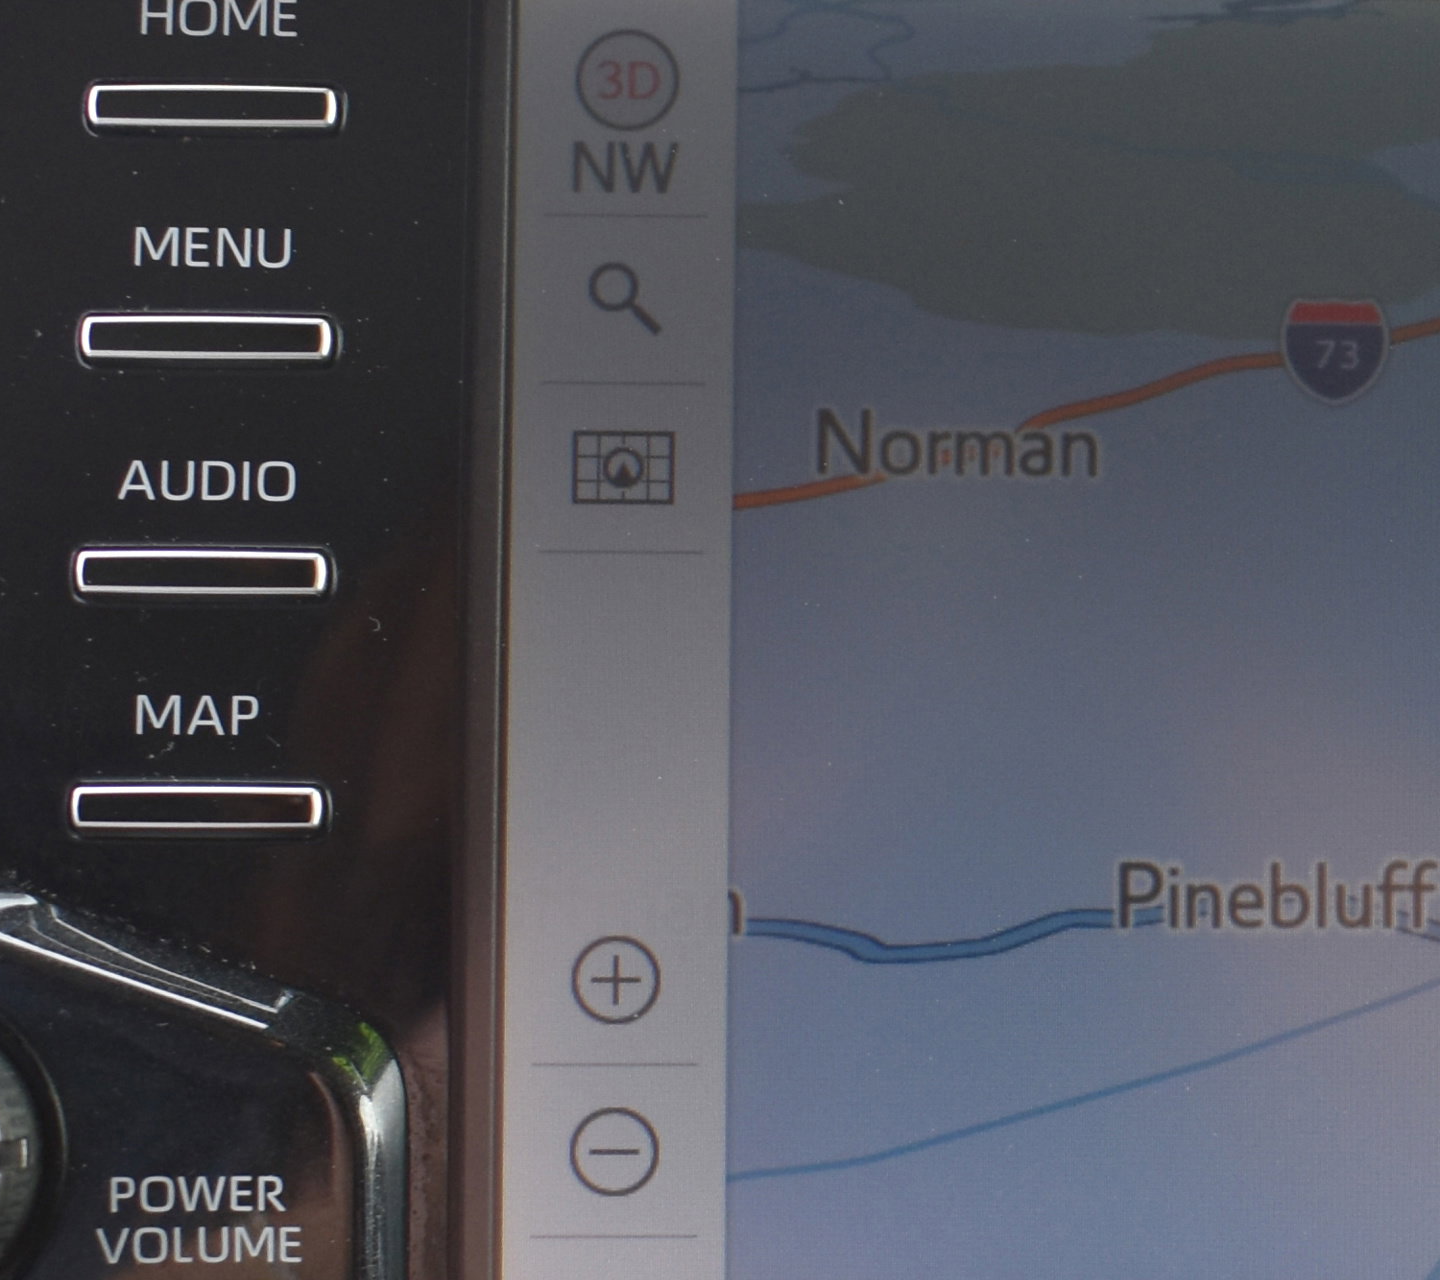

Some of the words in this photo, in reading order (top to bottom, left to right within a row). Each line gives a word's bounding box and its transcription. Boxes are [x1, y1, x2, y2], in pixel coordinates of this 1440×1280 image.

[597, 59, 662, 100] 3D
[571, 139, 680, 195] NW
[133, 226, 293, 269] MENU
[1315, 339, 1360, 371] 73
[814, 408, 1100, 478] Norman
[117, 459, 298, 503] AUDIO
[134, 694, 260, 736] MAP
[1117, 859, 1439, 930] Pinebluff
[109, 1174, 287, 1213] POWER
[95, 1225, 303, 1264] VOLUME
